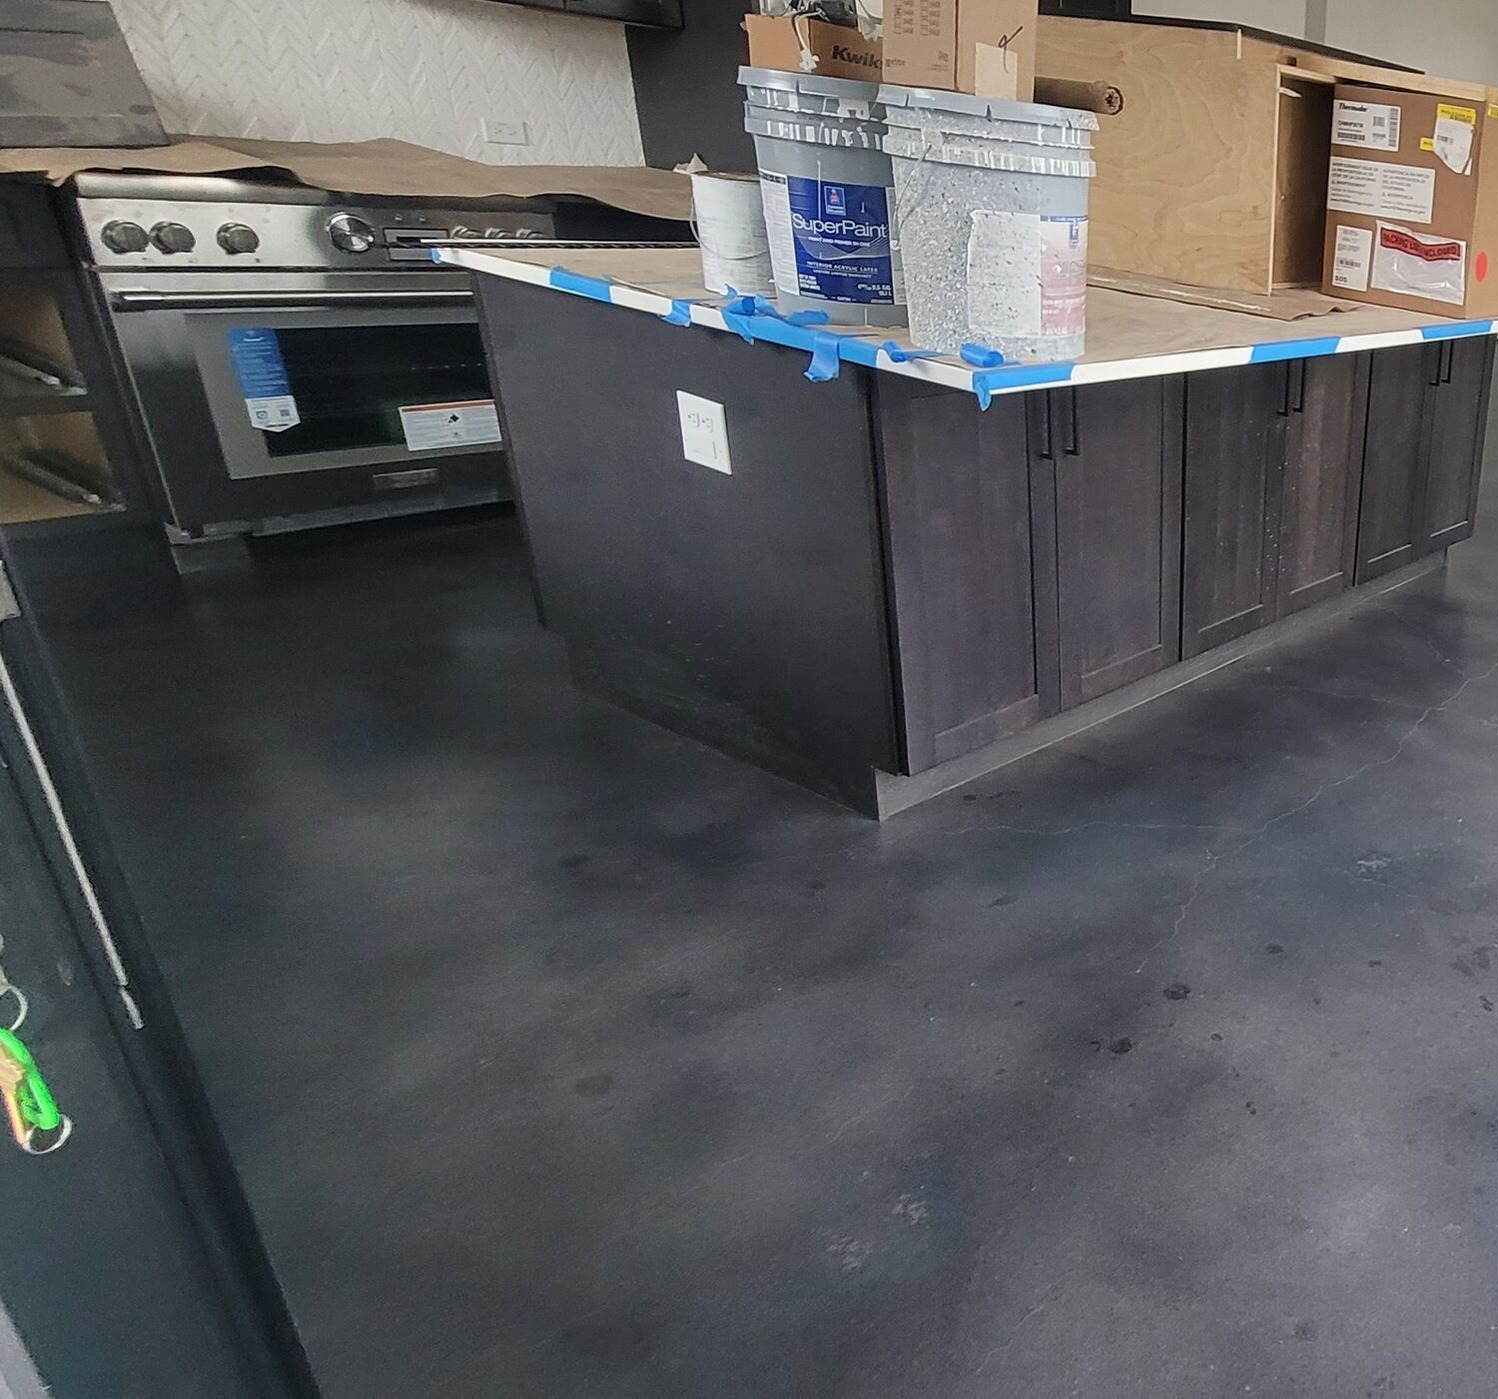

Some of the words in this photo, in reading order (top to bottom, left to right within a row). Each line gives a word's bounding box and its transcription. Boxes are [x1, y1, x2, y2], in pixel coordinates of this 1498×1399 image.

[831, 45, 883, 69] Kwik
[792, 212, 888, 239] SuperPaint
[806, 261, 833, 269] INTERIOR
[833, 263, 858, 271] ACRYLIC
[860, 265, 879, 273] LATEX
